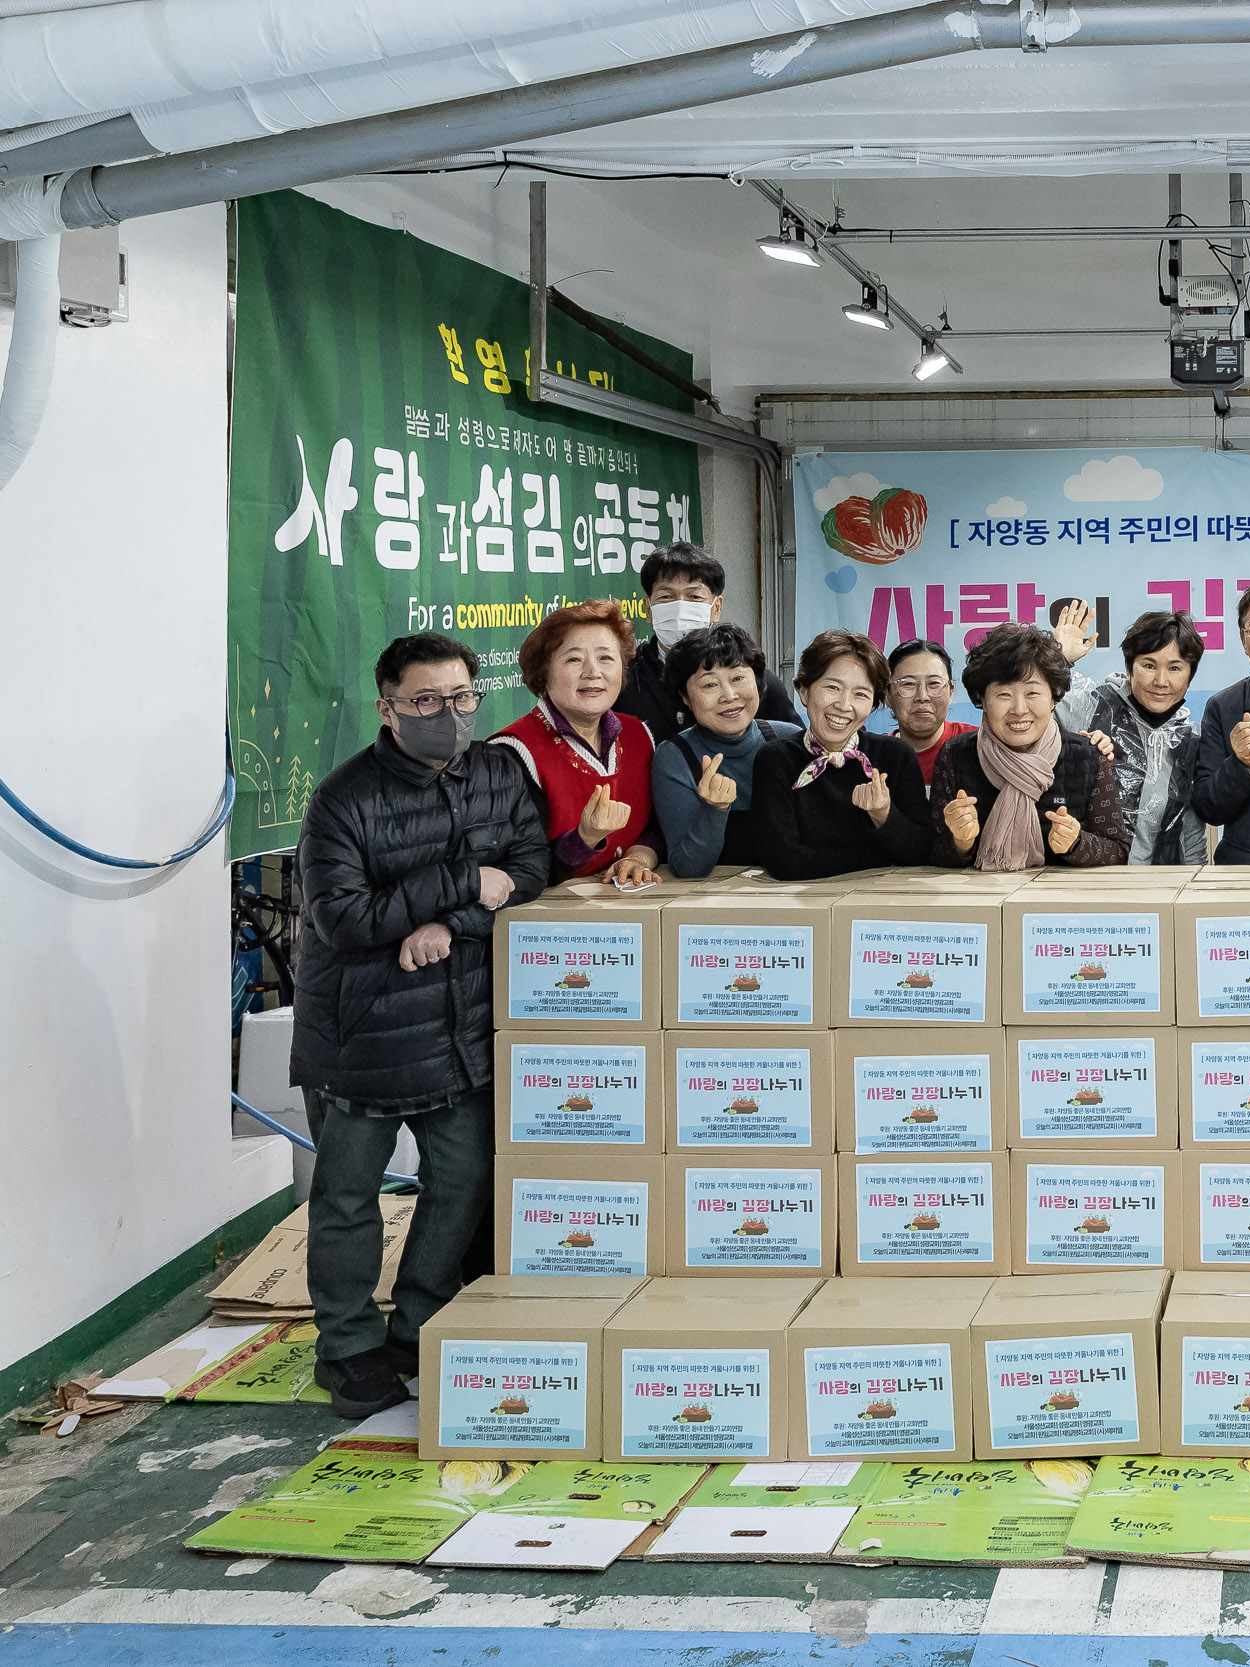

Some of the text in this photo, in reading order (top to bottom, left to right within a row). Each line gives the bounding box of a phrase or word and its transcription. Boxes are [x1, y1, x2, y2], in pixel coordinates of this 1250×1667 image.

[968, 519, 1049, 546] 자양동
[1057, 517, 1110, 545] 지역
[1118, 515, 1198, 544] 주민의
[408, 596, 436, 631] For
[442, 604, 454, 630] a
[456, 594, 542, 630] community
[546, 594, 559, 618] of
[1034, 943, 1150, 957] 사랑의 김장나누기
[1209, 947, 1249, 961] 사랑의
[520, 952, 633, 965] 사랑의 김장나누기
[690, 954, 804, 968] 사랑의 김장나누기
[862, 950, 977, 966] 사랑의 김장나누기
[523, 1074, 636, 1088] 사랑의 김장나누기
[1031, 1067, 1146, 1082] 사랑의 김장나누기
[1204, 1072, 1244, 1085] 사랑의
[688, 1077, 801, 1090] 사랑의 김장나누기
[866, 1085, 981, 1100] 사랑의 김장나누기
[697, 1198, 812, 1212] 사랑의 김장나누기
[868, 1193, 984, 1206] 사랑의 김장나누기
[1038, 1195, 1155, 1209] 사랑의 김장나누기
[524, 1209, 638, 1226] 사랑의 김장나누기
[245, 1268, 287, 1299] coupang
[819, 1362, 837, 1370] 자양동
[852, 1361, 871, 1369] 주민의
[892, 1359, 922, 1367] 겨울나기를
[453, 1374, 577, 1390] 사랑의 김장나누기
[1000, 1366, 1126, 1387] 사랑의 김장나누기
[1195, 1370, 1238, 1385] 사랑의
[635, 1382, 759, 1396] 사랑의 김장나누기
[818, 1376, 943, 1395] 사랑의 김장나누기
